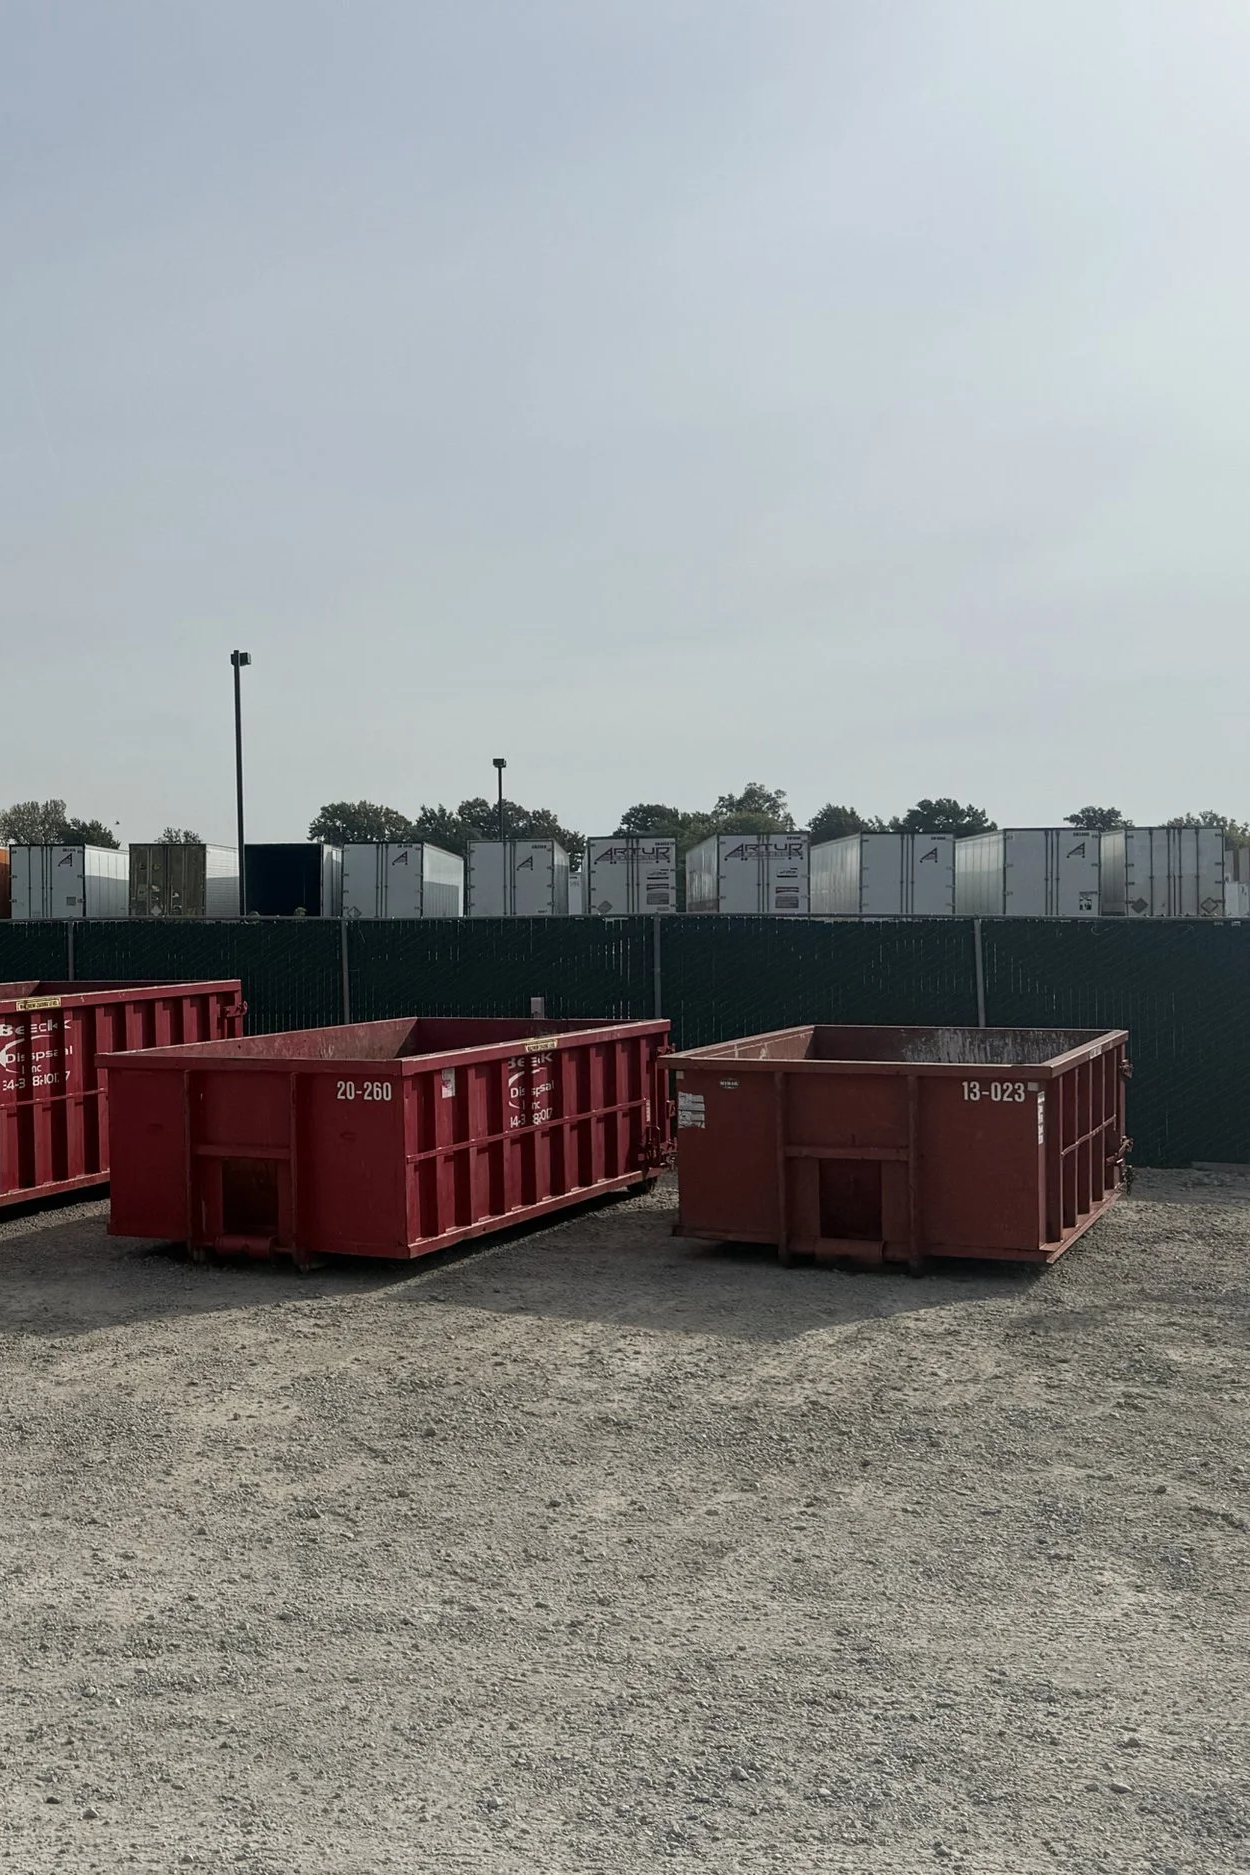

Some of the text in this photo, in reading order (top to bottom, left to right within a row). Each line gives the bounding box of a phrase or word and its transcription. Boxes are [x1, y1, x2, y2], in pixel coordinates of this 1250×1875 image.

[594, 846, 670, 864] ARTUR
[724, 843, 803, 861] ARTUR
[5, 1045, 73, 1063] Dispsal
[336, 1081, 392, 1101] 20-260
[961, 1081, 1025, 1102] 13-023
